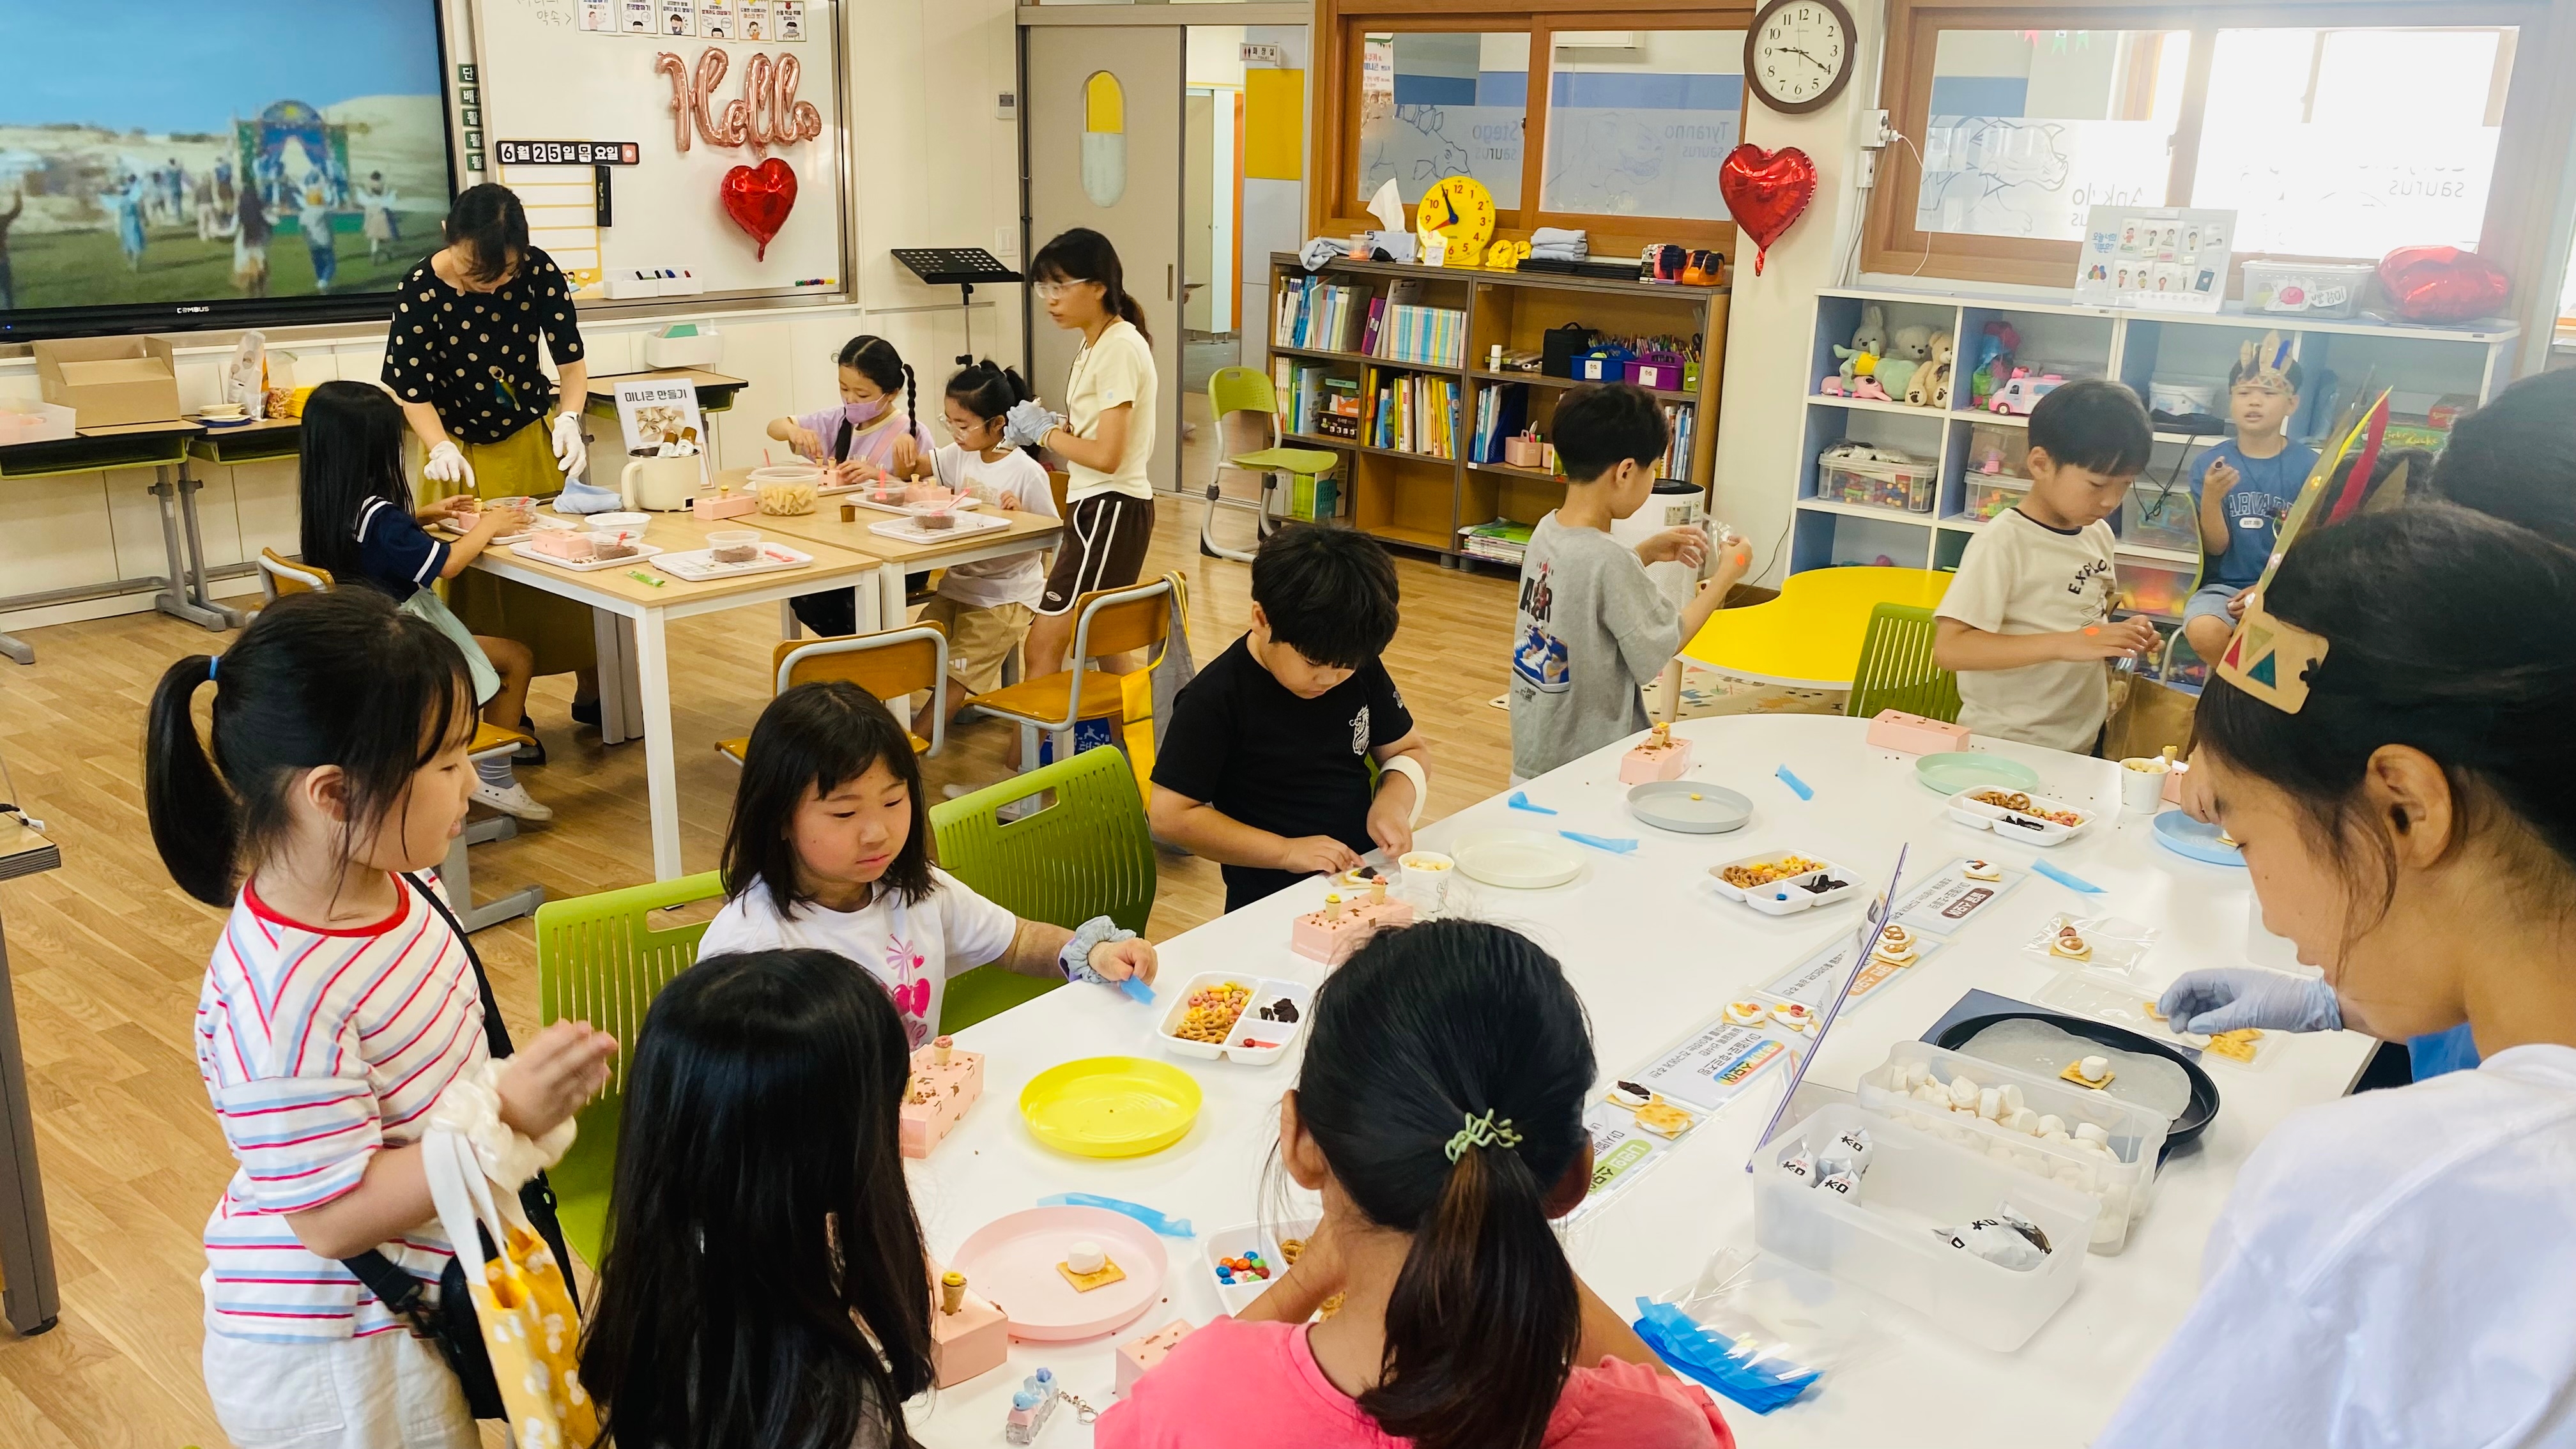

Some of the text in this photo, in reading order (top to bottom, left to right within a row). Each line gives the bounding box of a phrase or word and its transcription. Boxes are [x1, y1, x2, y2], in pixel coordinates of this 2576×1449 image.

[537, 10, 560, 26] 약속
[1784, 14, 1791, 25] 11
[1799, 9, 1809, 20] 12
[1818, 13, 1821, 24] 1
[1770, 28, 1780, 40] 10
[1827, 26, 1834, 37] 2
[1253, 47, 1274, 56] 화장실
[1765, 47, 1772, 58] 9
[1830, 45, 1837, 57] 3
[463, 66, 474, 81] 단
[1767, 66, 1775, 77] 8
[1823, 64, 1831, 75] 4
[1779, 80, 1786, 91] 7
[1812, 78, 1819, 89] 5
[1795, 84, 1802, 95] 6
[467, 111, 479, 125] 활
[470, 133, 480, 147] 활
[579, 145, 618, 161] 목요일
[471, 155, 482, 169] 활
[1454, 185, 1463, 194] 12
[1470, 190, 1474, 199] 1
[1430, 200, 1439, 208] 10
[1478, 201, 1483, 210] 2
[1425, 215, 1430, 224] 9
[1480, 217, 1485, 226] 3
[1473, 233, 1479, 241] 4
[2092, 232, 2117, 243] 오늘 너의
[1448, 246, 1454, 255] 6
[1462, 243, 1468, 252] 5
[2093, 243, 2114, 254] 기분은?
[624, 389, 687, 402] 미니콘 만들기
[2067, 559, 2111, 595] EXPLO
[1718, 1061, 1755, 1083] 스모어
[1607, 1144, 1646, 1169] 나만의
